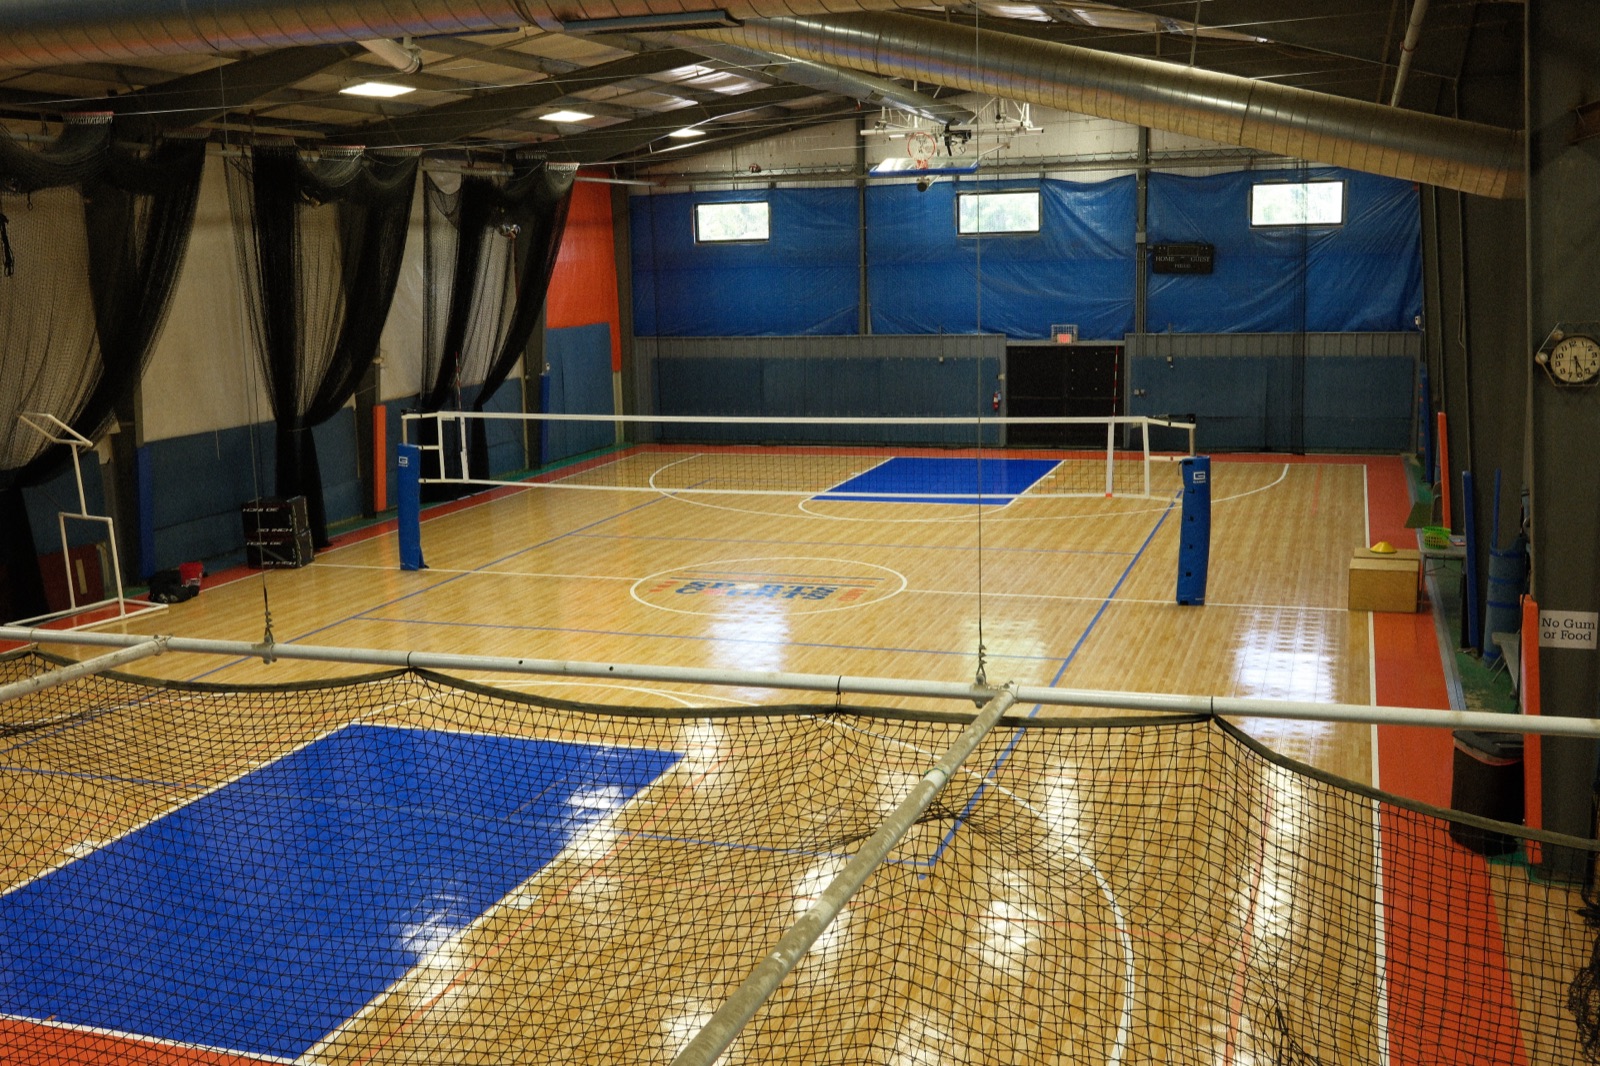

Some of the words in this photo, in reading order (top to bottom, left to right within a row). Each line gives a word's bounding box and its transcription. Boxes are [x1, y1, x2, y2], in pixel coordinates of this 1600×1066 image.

[1542, 618, 1560, 628] No
[1564, 618, 1596, 629] Gum
[1560, 630, 1591, 640] Food
